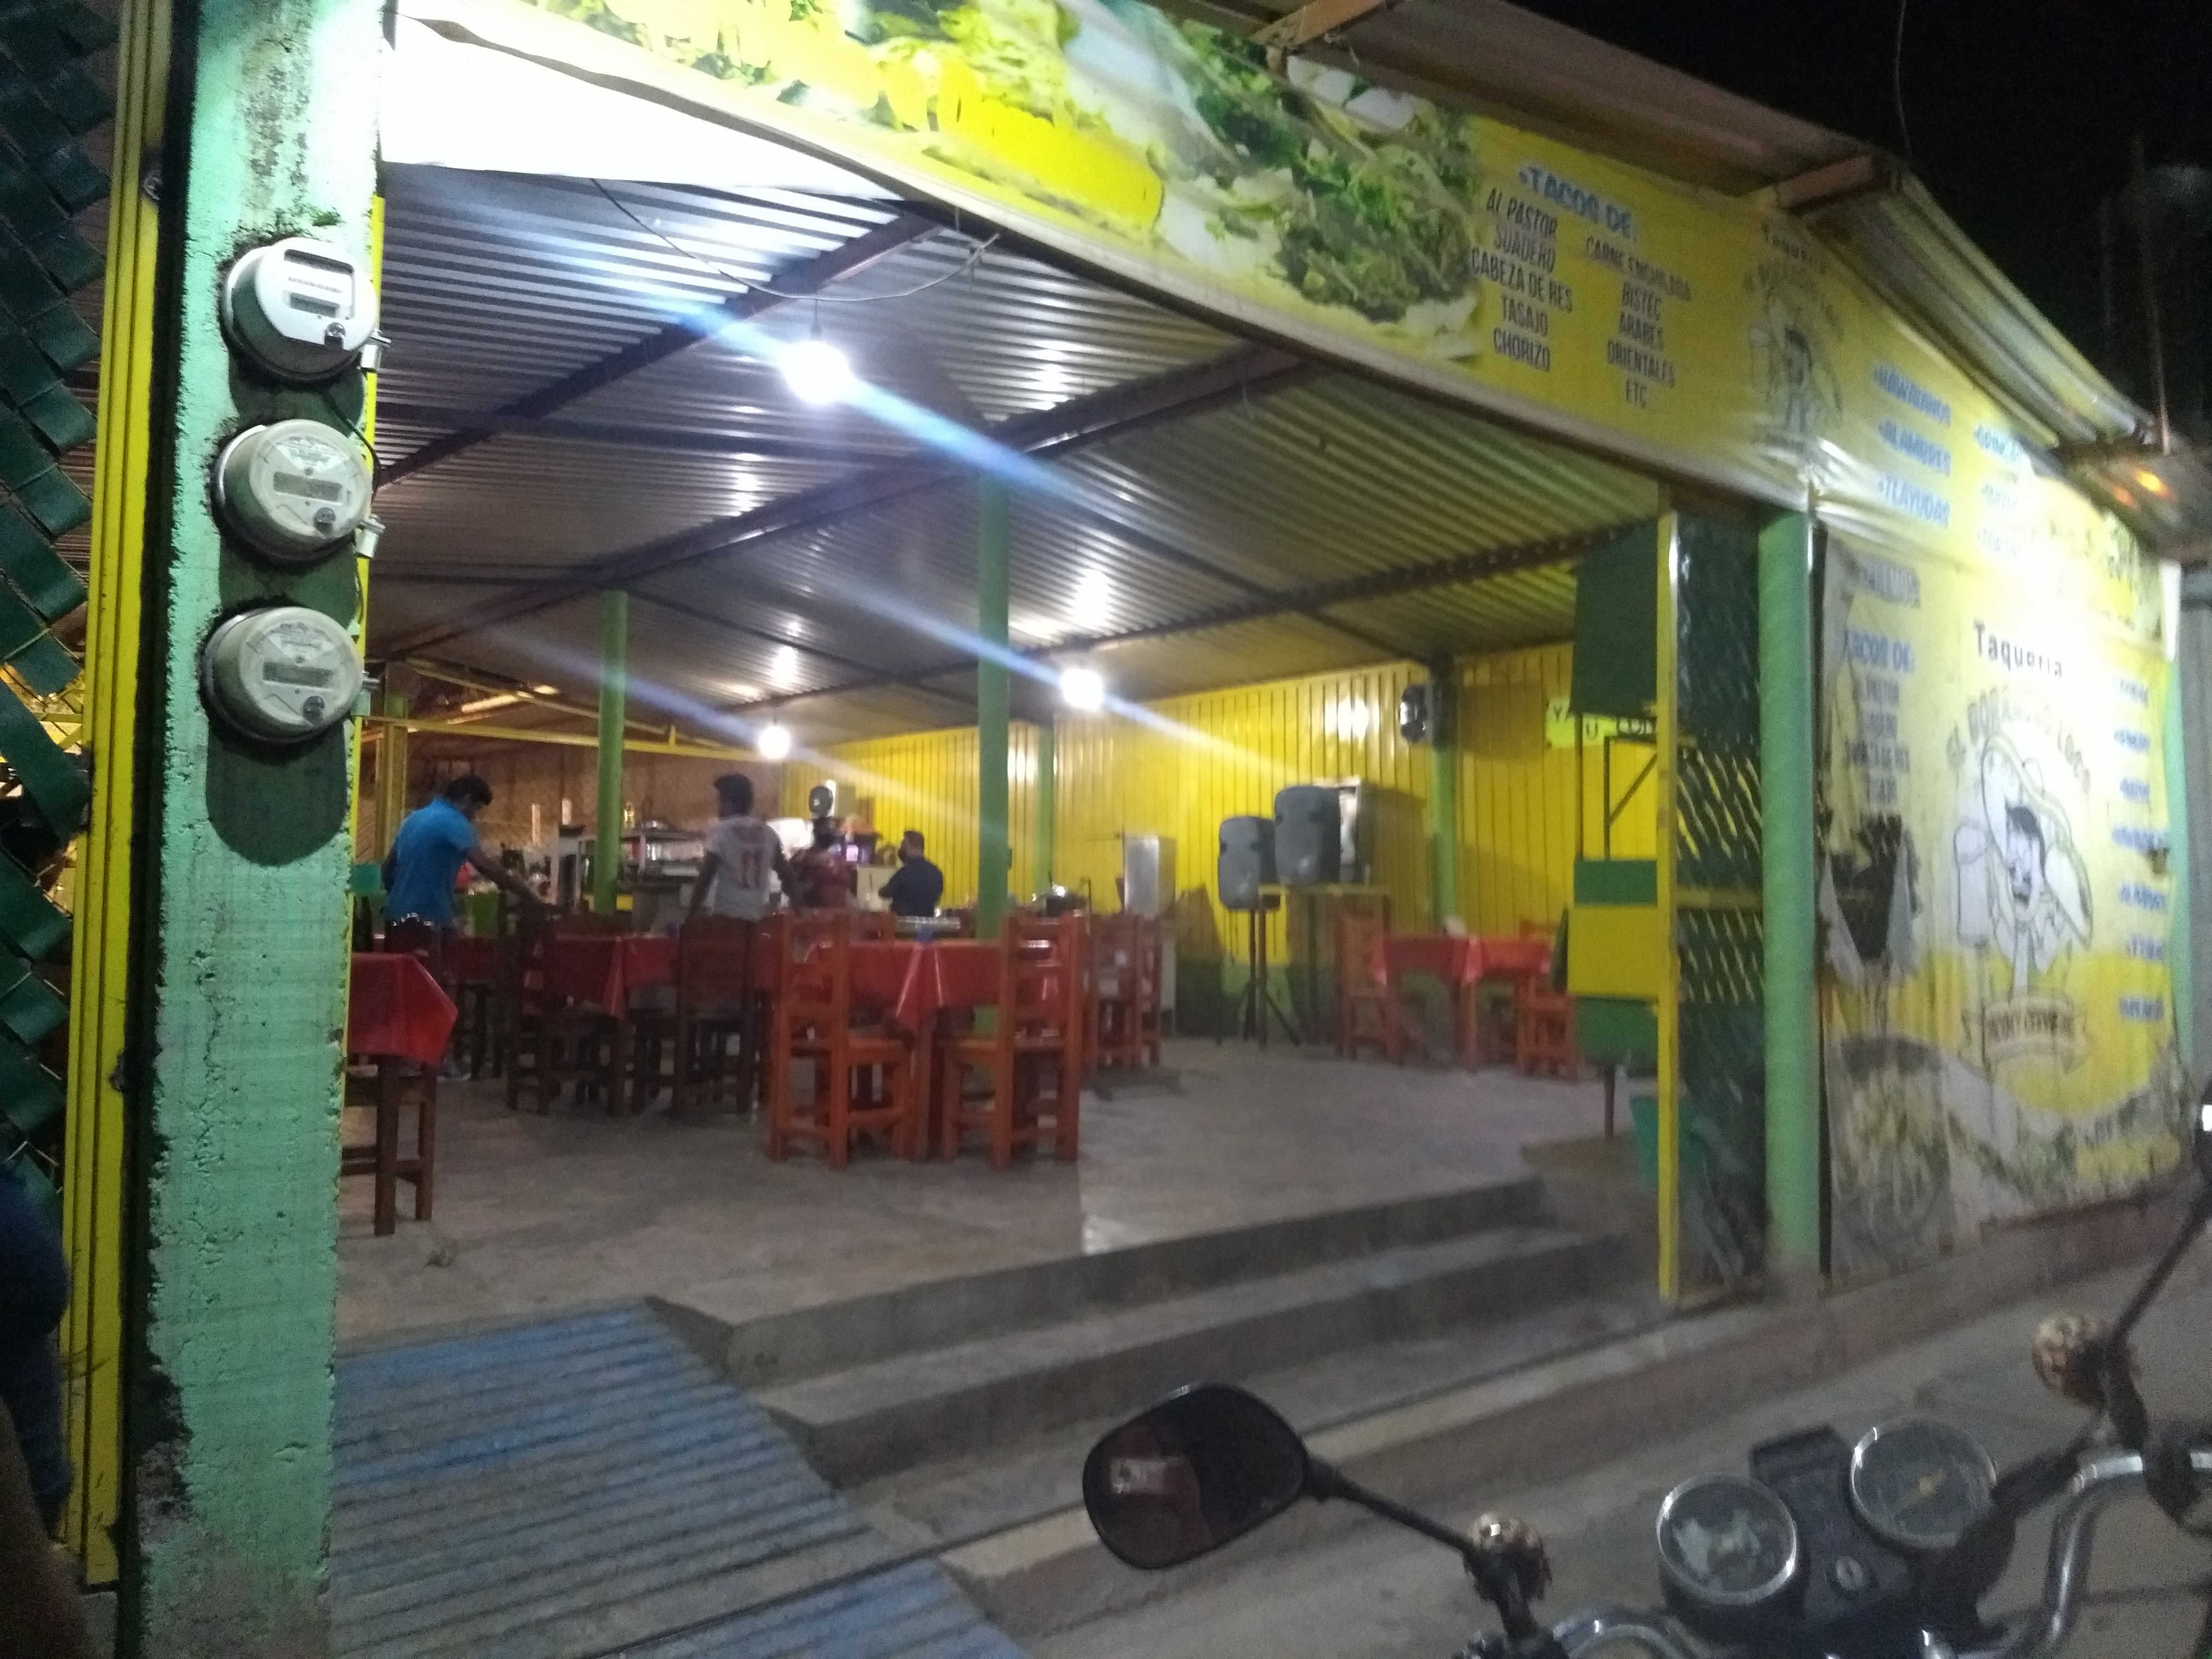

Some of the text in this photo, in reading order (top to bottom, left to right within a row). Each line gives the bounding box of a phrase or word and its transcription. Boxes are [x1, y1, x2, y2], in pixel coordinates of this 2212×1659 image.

[1486, 188, 1559, 238] AL PASTOR
[1494, 223, 1556, 274] SUADERO
[1471, 247, 1573, 314] CABEZA DE RES
[1622, 281, 1662, 321] BISTEC
[1502, 295, 1549, 337] TASAJO
[1493, 327, 1551, 373] CHORIZO
[1973, 618, 2063, 678] Taqueria
